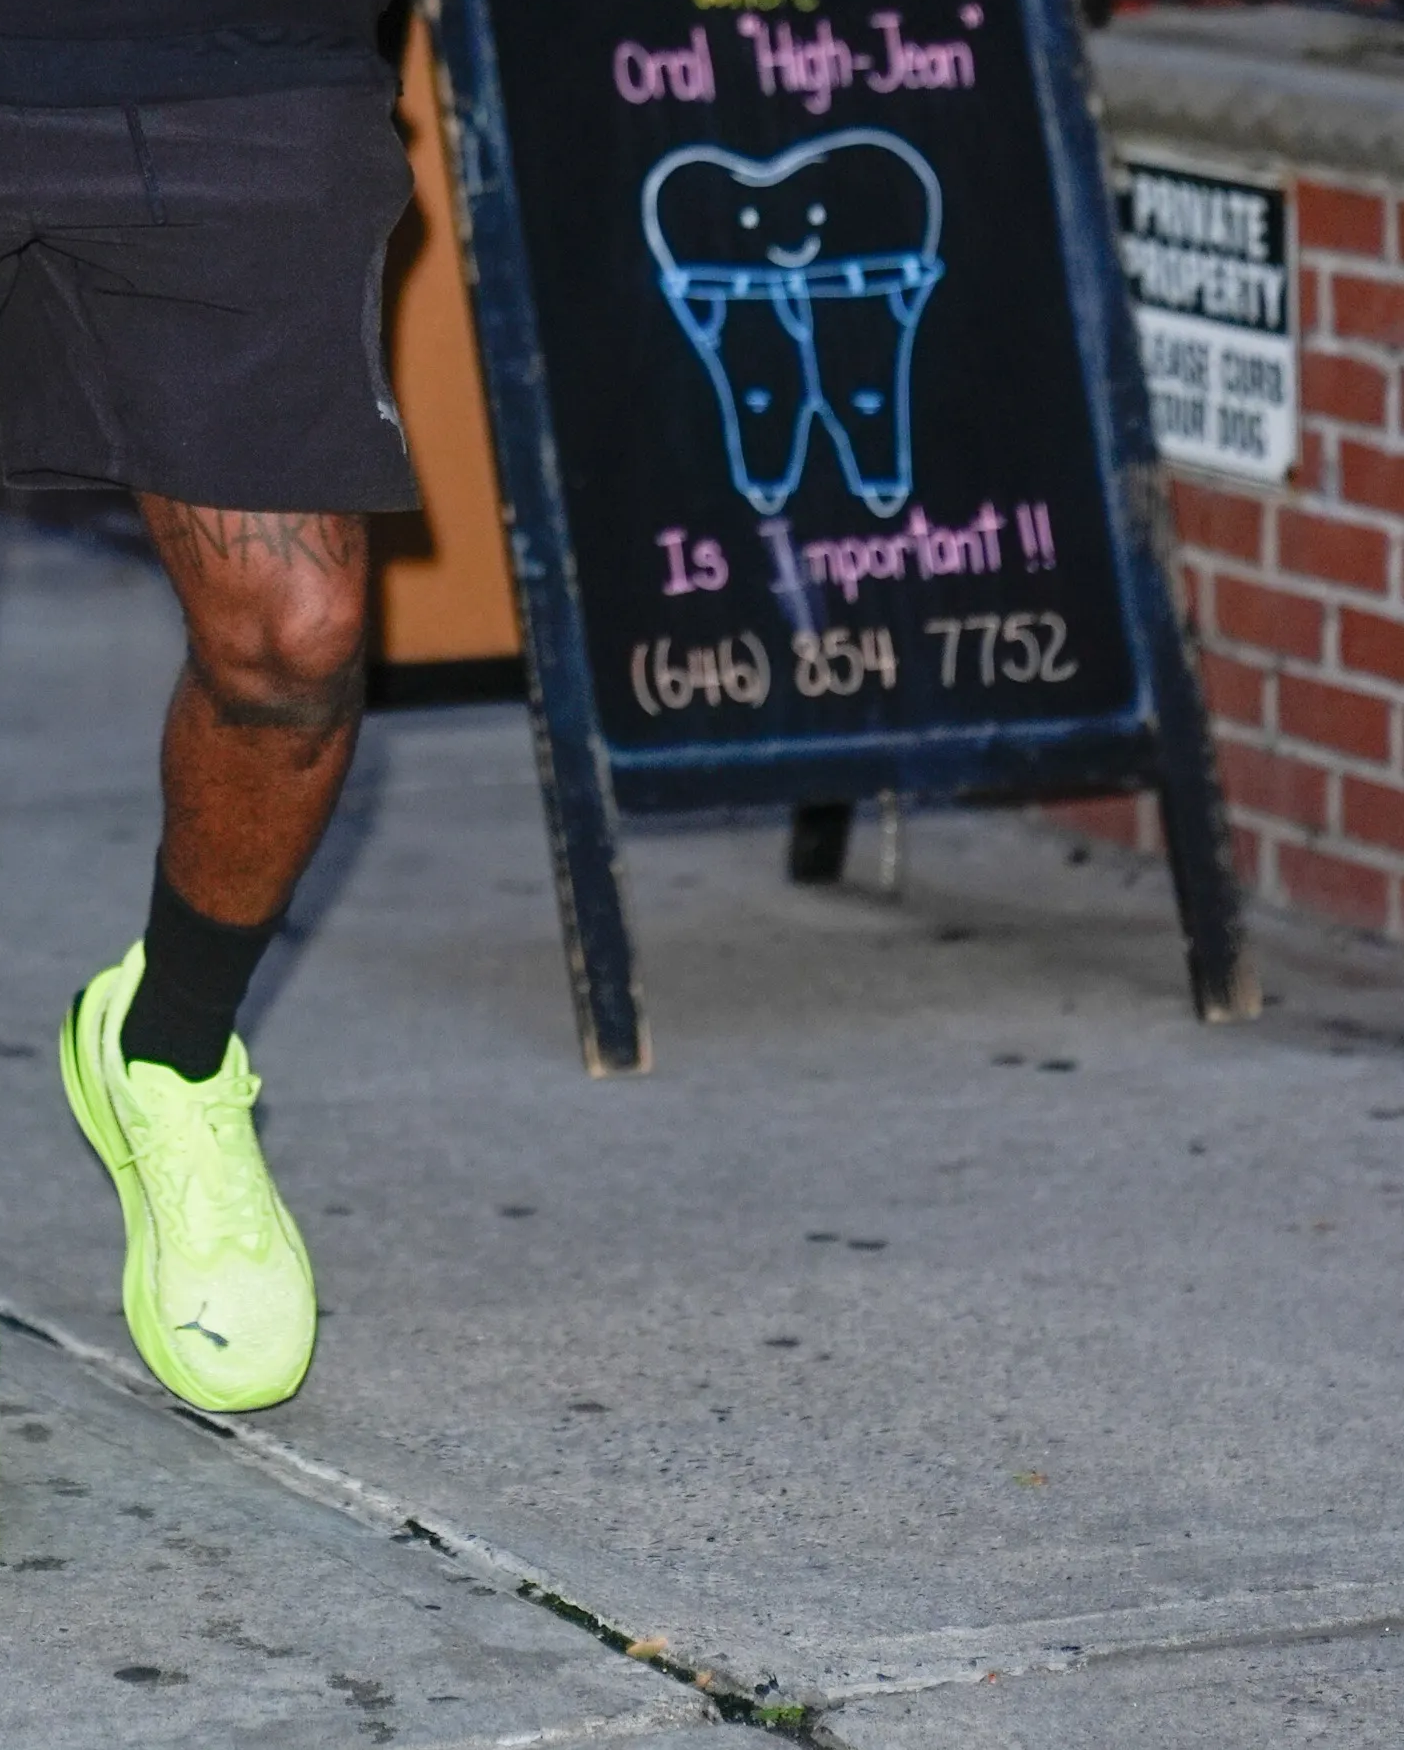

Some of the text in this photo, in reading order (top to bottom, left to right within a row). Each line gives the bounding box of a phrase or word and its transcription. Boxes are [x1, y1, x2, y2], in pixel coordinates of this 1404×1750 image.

[612, 23, 717, 105] Oral
[1133, 172, 1270, 261] PRIVATE
[1120, 236, 1285, 331] PROPERTY
[654, 526, 729, 597] Is
[630, 610, 1080, 718] (646) 854 7752
